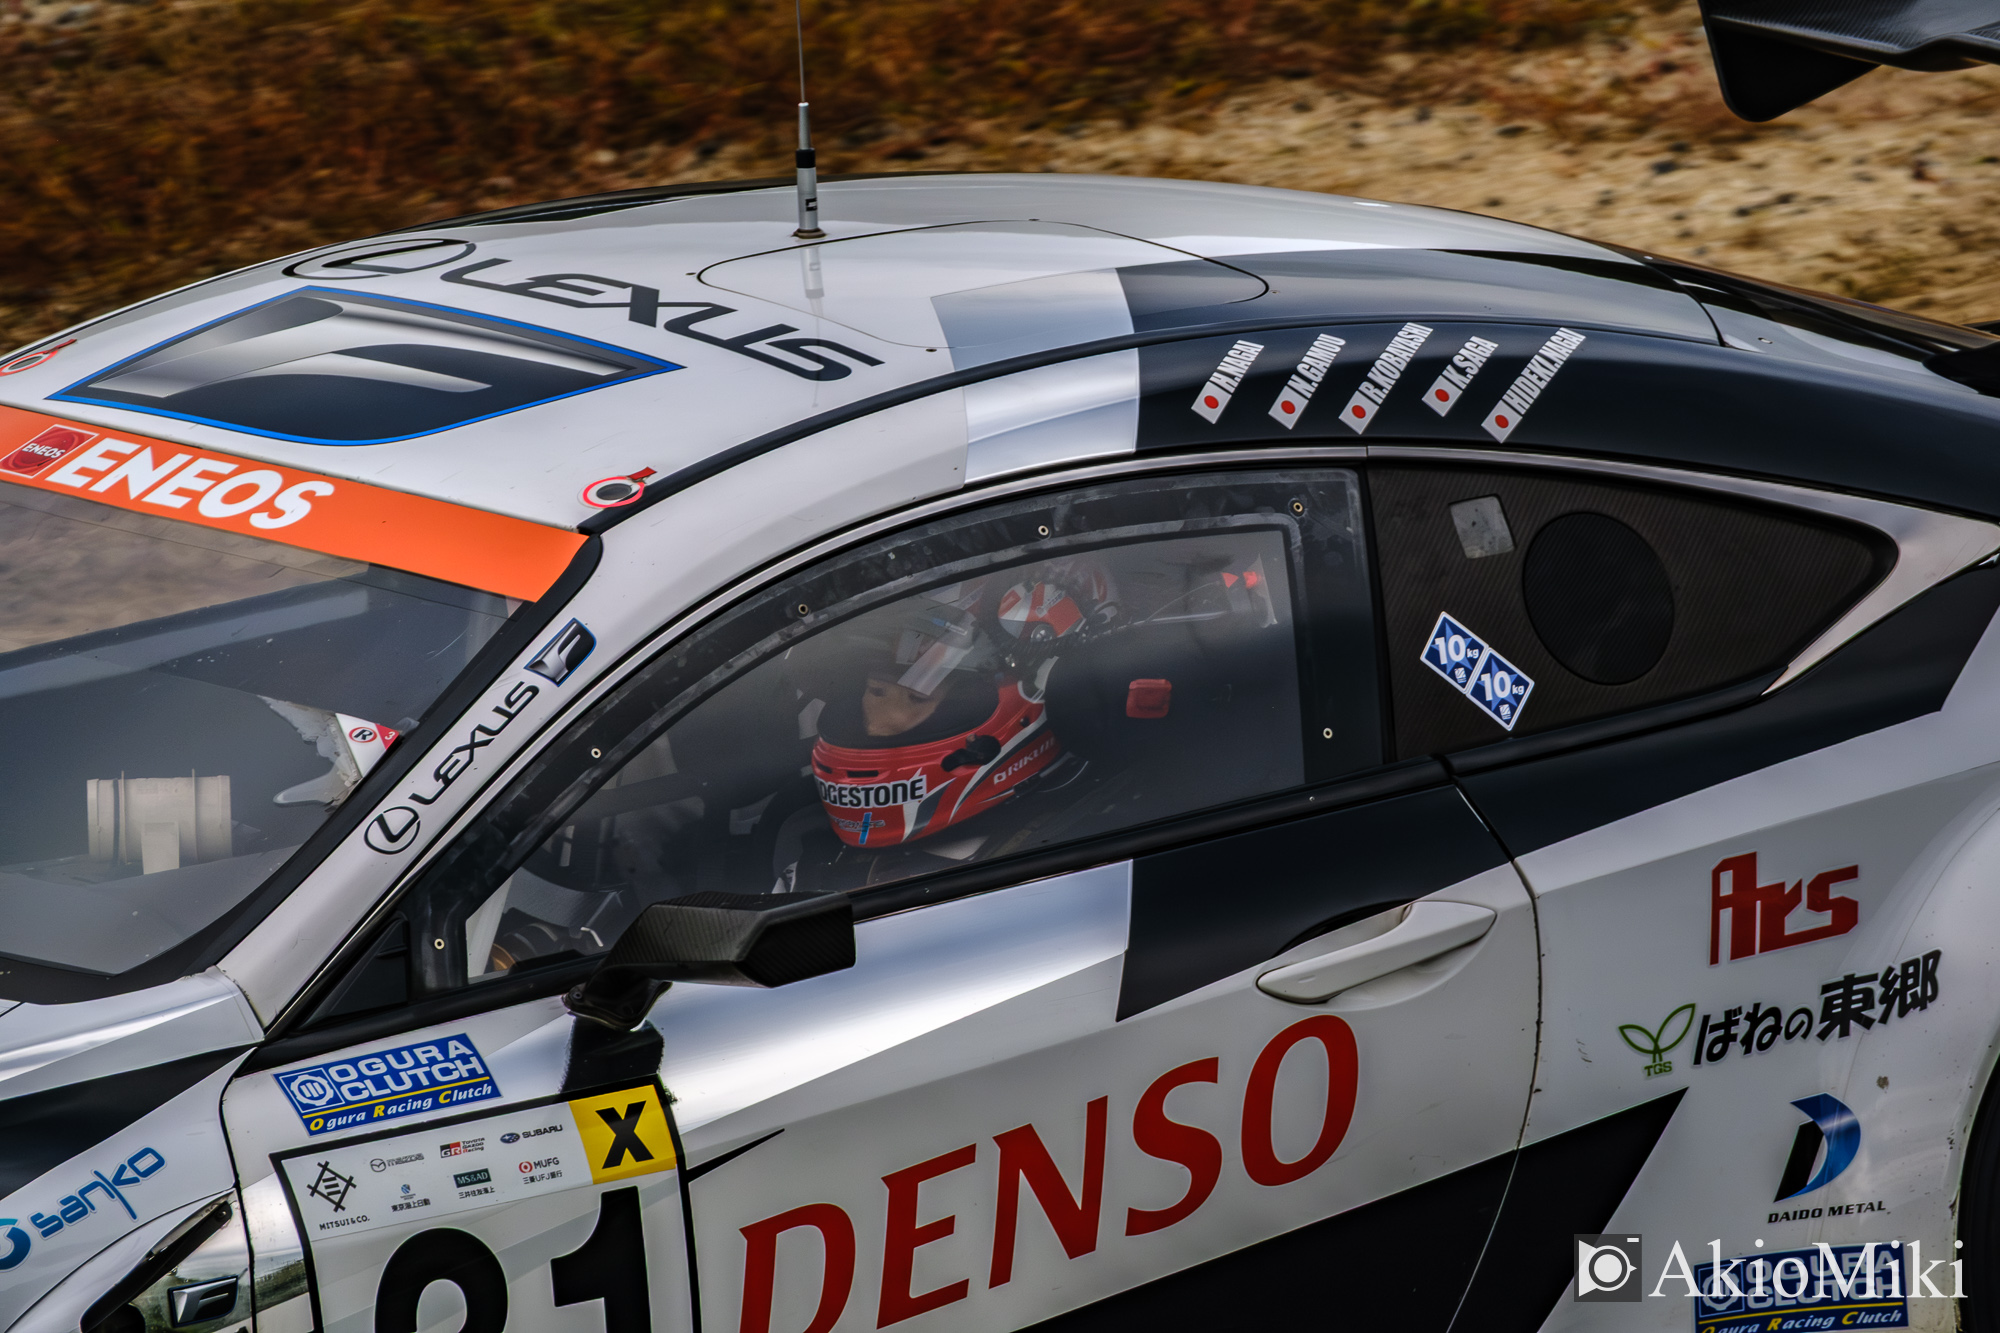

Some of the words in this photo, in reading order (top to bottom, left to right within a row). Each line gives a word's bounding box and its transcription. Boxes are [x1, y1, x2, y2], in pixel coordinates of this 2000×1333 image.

[440, 257, 886, 381] LEXUS
[1209, 339, 1265, 393] H.NAGAI
[1287, 333, 1346, 399] N.GAMOU
[1358, 322, 1434, 404] R.KOBAYASHI
[1442, 335, 1499, 389] K.SAGA
[1501, 327, 1587, 414] HIDEKI.NAGAI
[22, 443, 66, 459] ENEOS
[45, 437, 334, 529] ENEOS
[408, 681, 540, 805] LEXUS
[1693, 949, 1942, 1066] ばねの東郷
[328, 1040, 474, 1083] OGURA
[339, 1056, 485, 1101] CLUTCH
[1644, 1061, 1673, 1077] TGS
[438, 1084, 492, 1105] Clutch
[441, 1145, 461, 1157] GR
[522, 1124, 563, 1138] SUBARU
[595, 1100, 654, 1170] X
[456, 1173, 489, 1185] MS&AD
[533, 1157, 560, 1169] MUFG
[738, 1015, 1359, 1333] DENSO
[30, 1147, 165, 1238] sanko
[1767, 1207, 1823, 1223] DAIDO
[1826, 1201, 1887, 1217] METAL
[319, 1214, 370, 1231] MITSUI&CO.
[1841, 1309, 1902, 1326] Clutch
